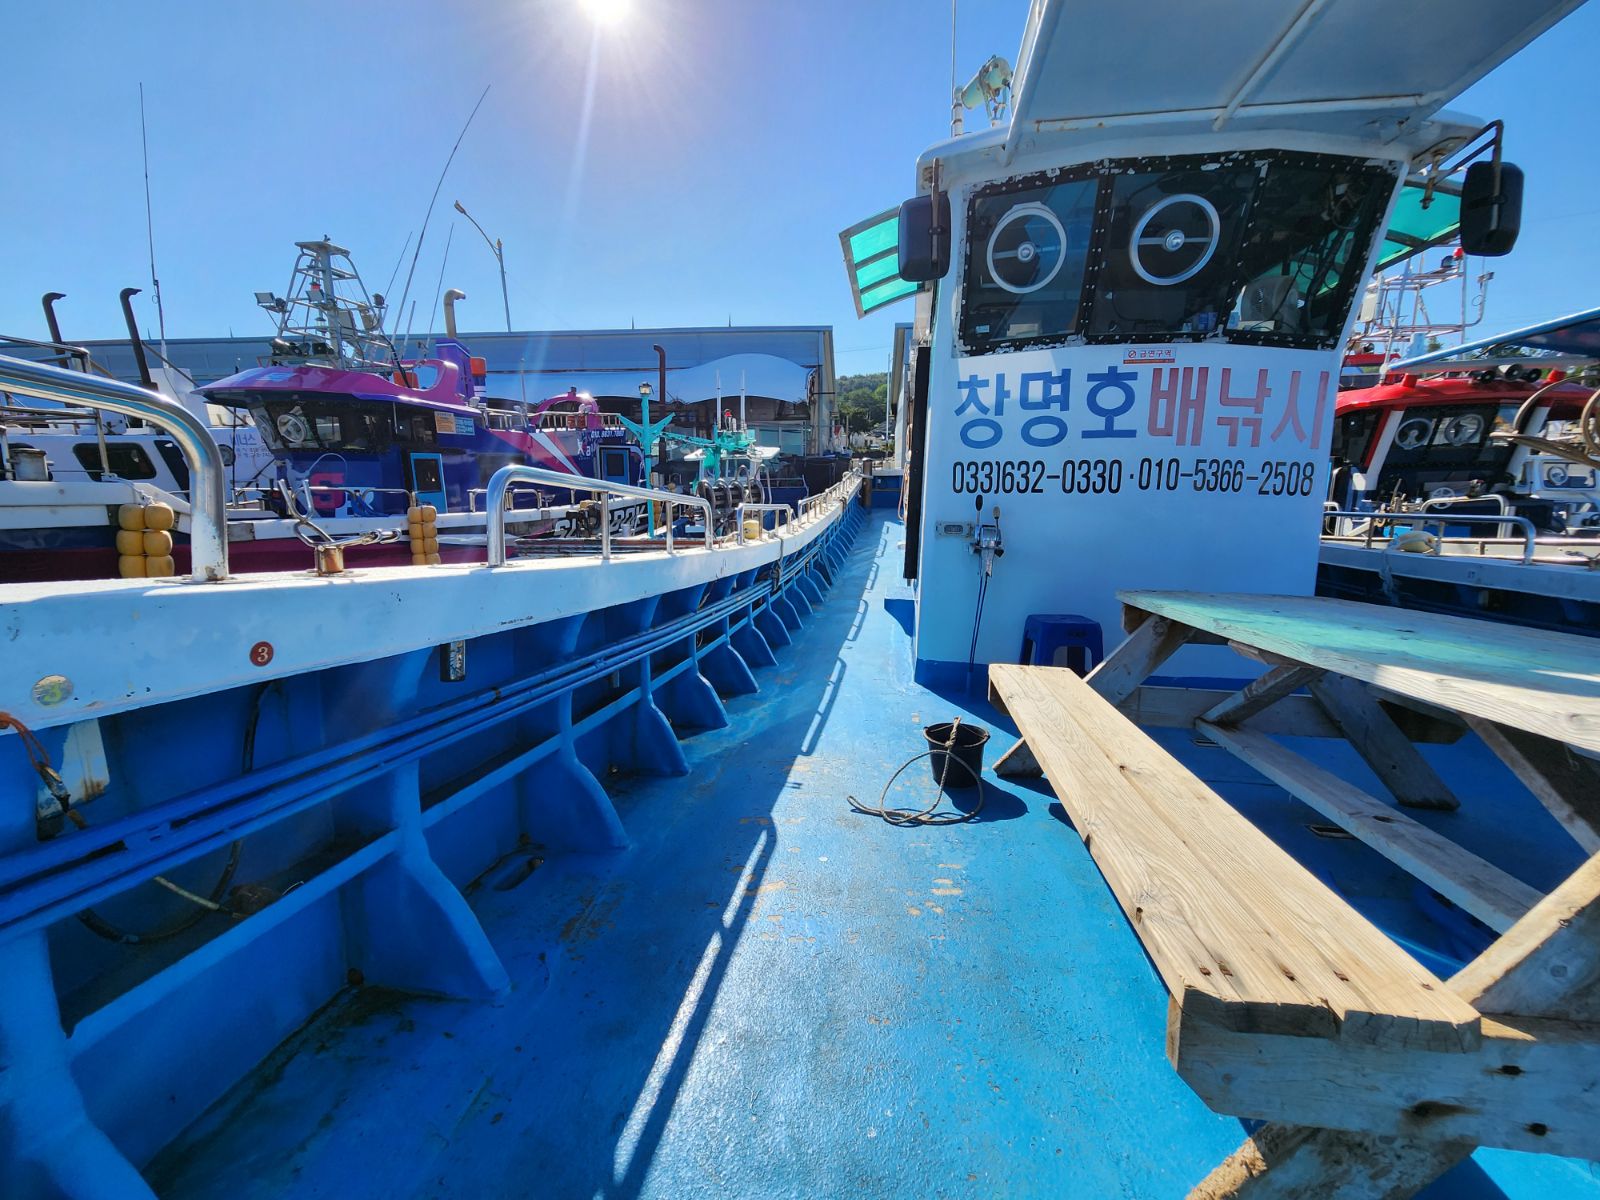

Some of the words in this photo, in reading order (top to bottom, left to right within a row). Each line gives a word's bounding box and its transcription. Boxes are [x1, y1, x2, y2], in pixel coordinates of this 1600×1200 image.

[954, 366, 1138, 449] 창명호
[1147, 367, 1330, 449] 배낚시
[257, 646, 269, 662] 3
